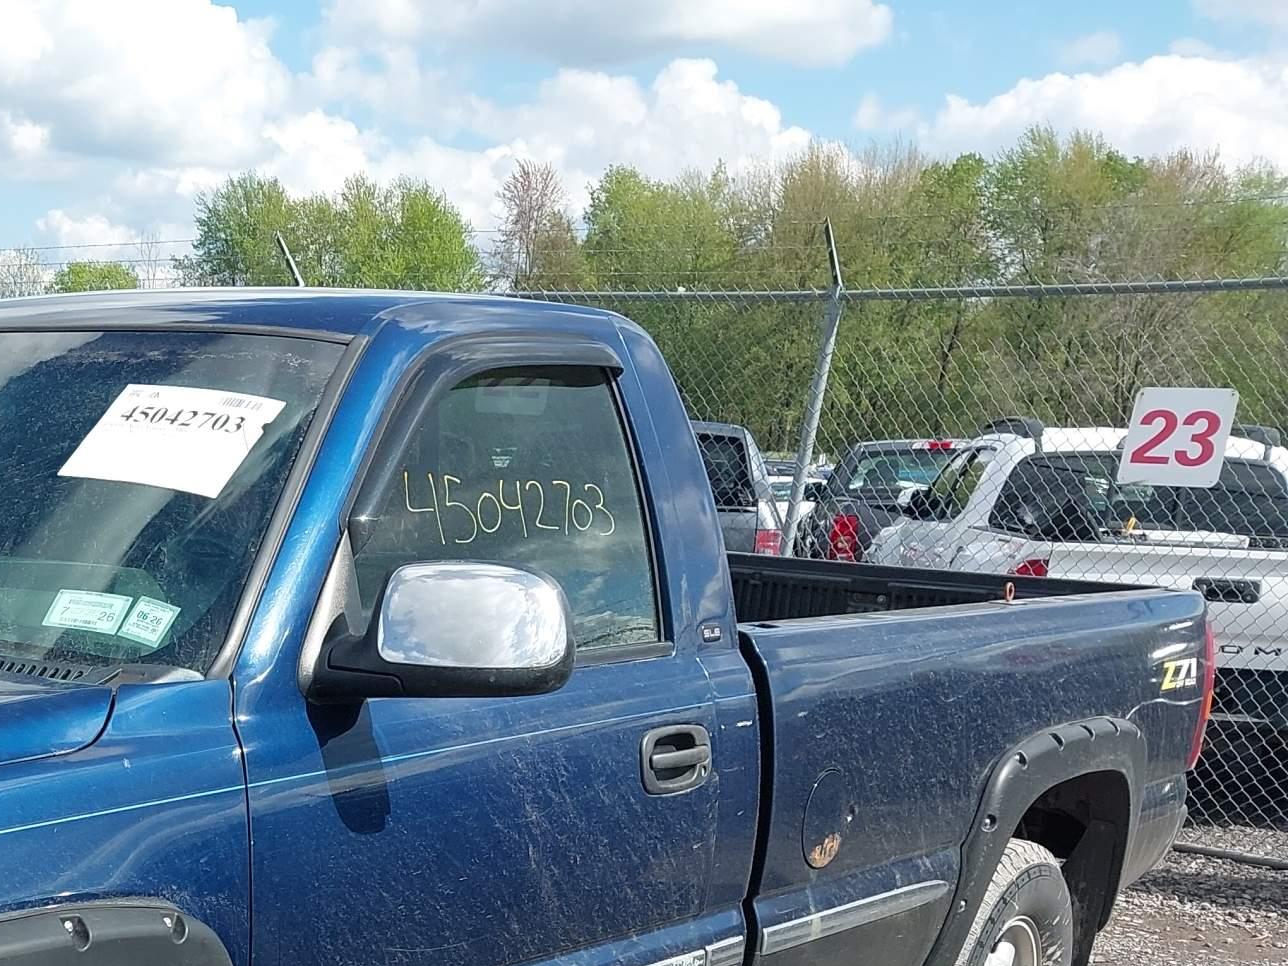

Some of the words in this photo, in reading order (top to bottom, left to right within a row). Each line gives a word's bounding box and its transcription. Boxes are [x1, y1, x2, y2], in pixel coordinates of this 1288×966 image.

[120, 405, 246, 434] 45042703
[1129, 408, 1222, 467] 23
[403, 470, 616, 545] 45042703
[97, 611, 116, 623] 26
[1160, 657, 1198, 691] Z71
